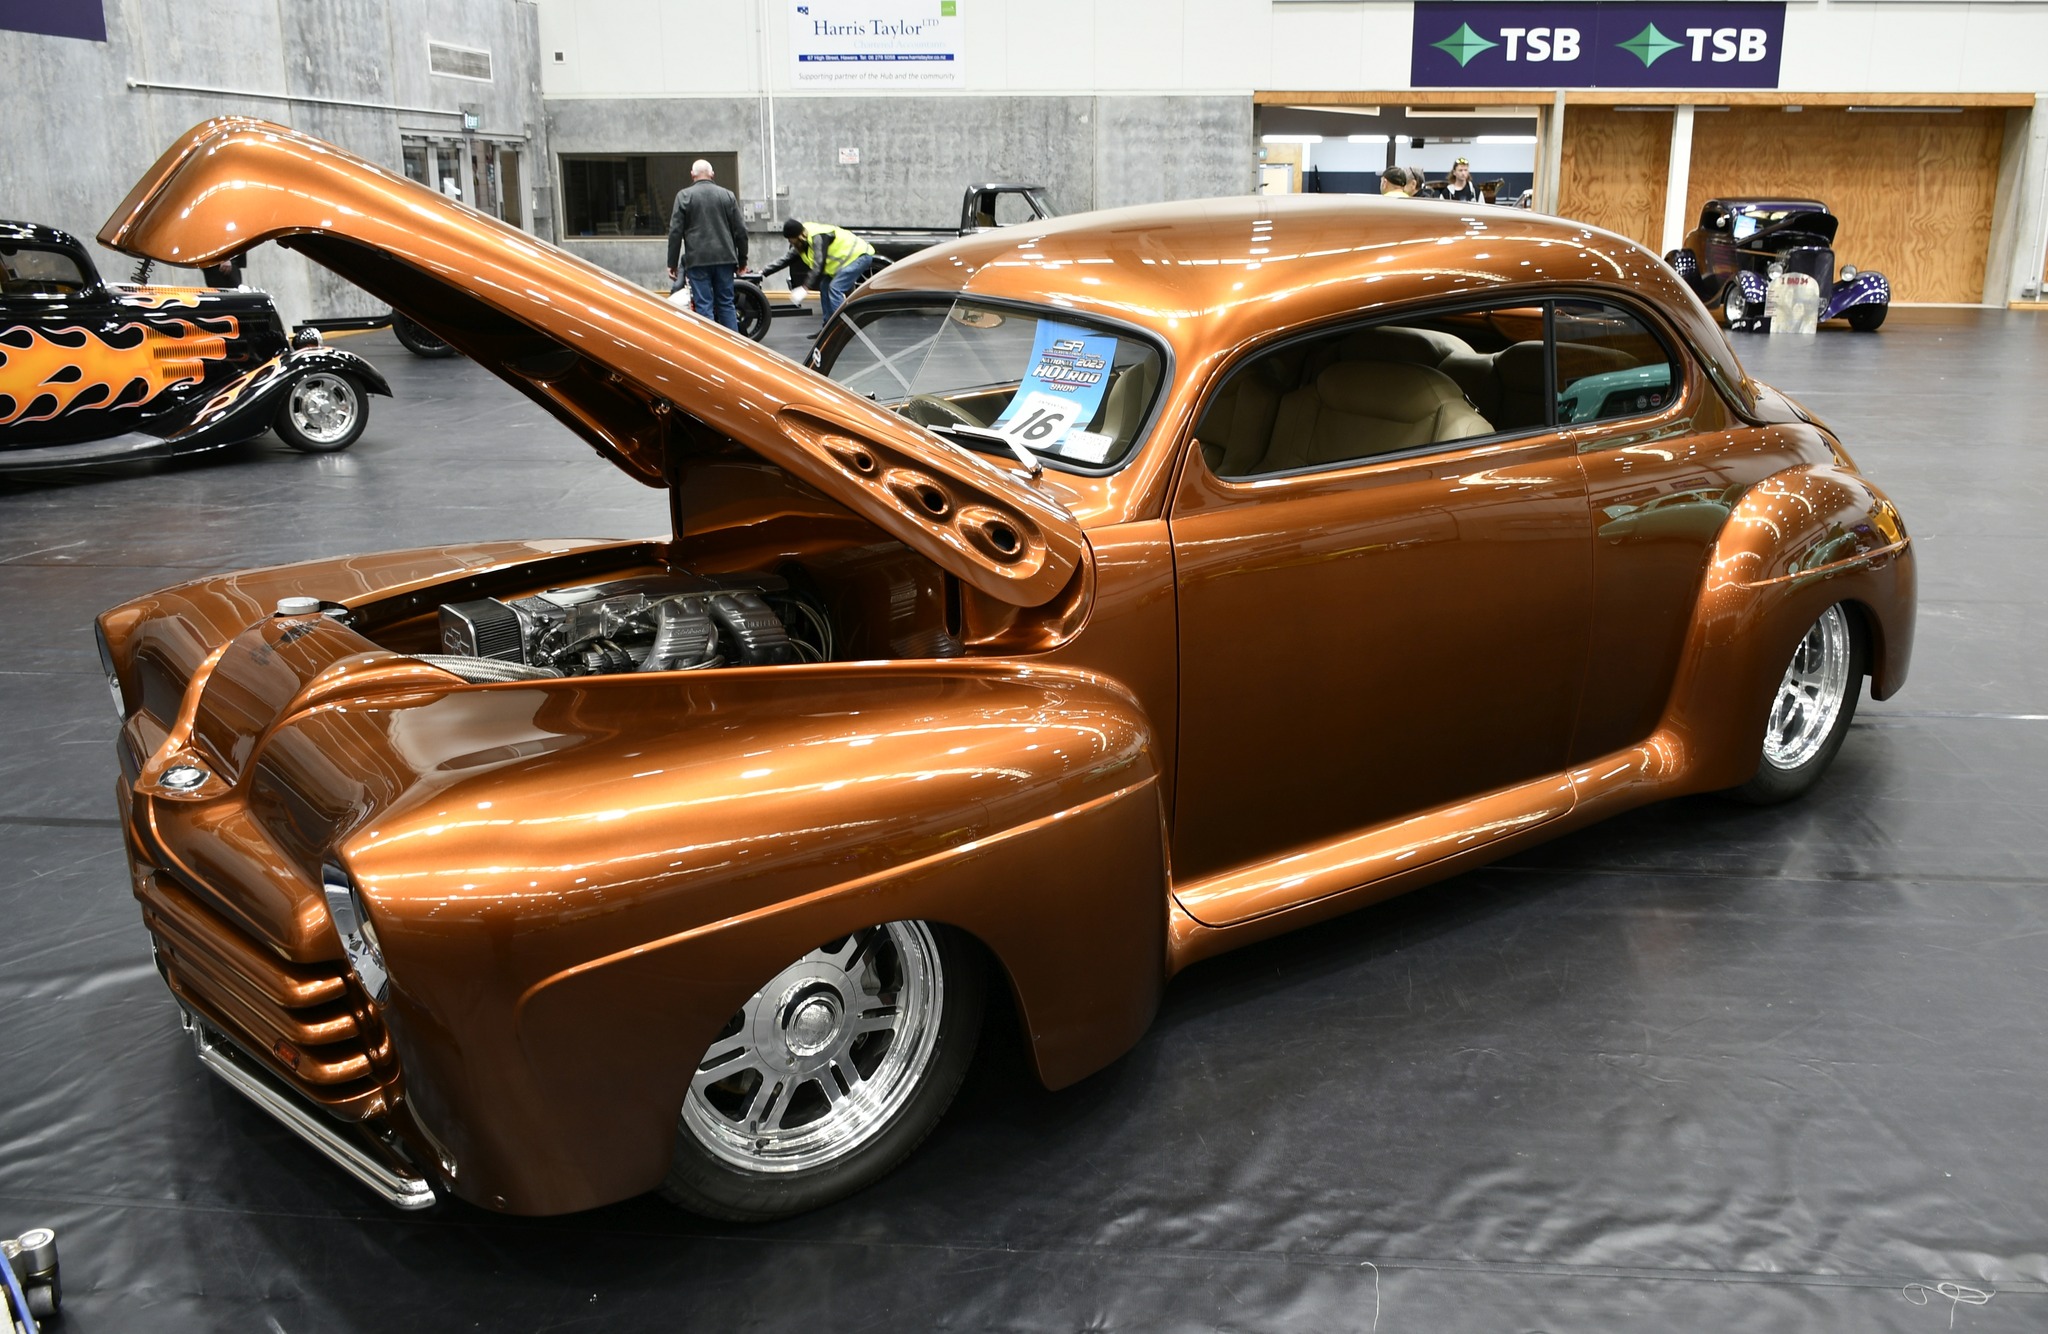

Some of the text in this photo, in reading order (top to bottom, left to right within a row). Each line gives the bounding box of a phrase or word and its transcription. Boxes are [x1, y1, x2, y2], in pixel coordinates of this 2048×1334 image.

[814, 19, 939, 39] Harris Taylor LTD
[1500, 27, 1581, 62] TSB
[1686, 27, 1768, 63] TSB
[799, 73, 833, 81] Supporting
[920, 73, 955, 81] community
[1040, 357, 1106, 369] NATIONAL 2023
[1049, 384, 1079, 393] SHOW
[1010, 408, 1065, 440] 16
